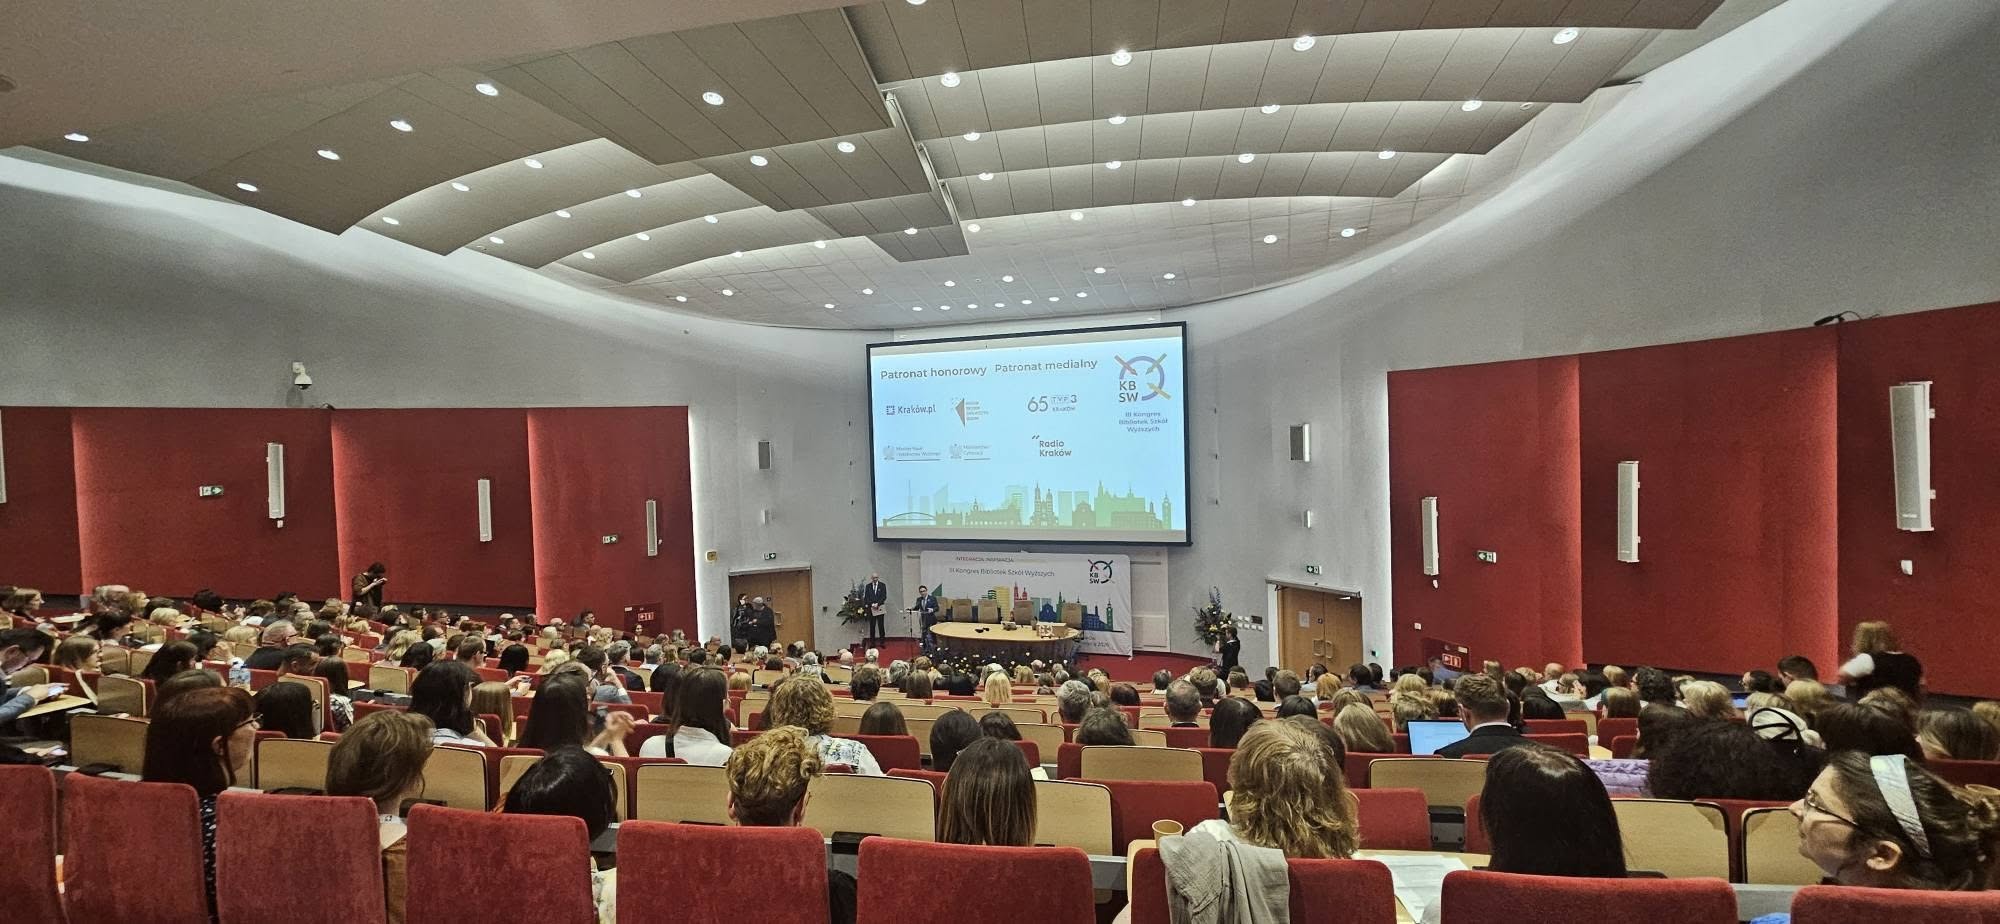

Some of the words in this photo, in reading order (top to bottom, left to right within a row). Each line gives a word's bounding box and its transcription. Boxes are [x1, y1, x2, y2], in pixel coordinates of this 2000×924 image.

[995, 363, 1042, 373] Patronat
[1045, 359, 1098, 370] medialny
[880, 370, 928, 380] Patronat
[930, 367, 987, 377] honorowy
[1119, 380, 1137, 391] KB
[1119, 392, 1139, 403] SW
[897, 404, 937, 415] Kraków.pl
[1027, 395, 1049, 413] 65
[1039, 440, 1065, 448] Radio
[1039, 449, 1072, 457] Kraków
[955, 567, 979, 575] Kongres
[980, 567, 1007, 575] Bibliotek
